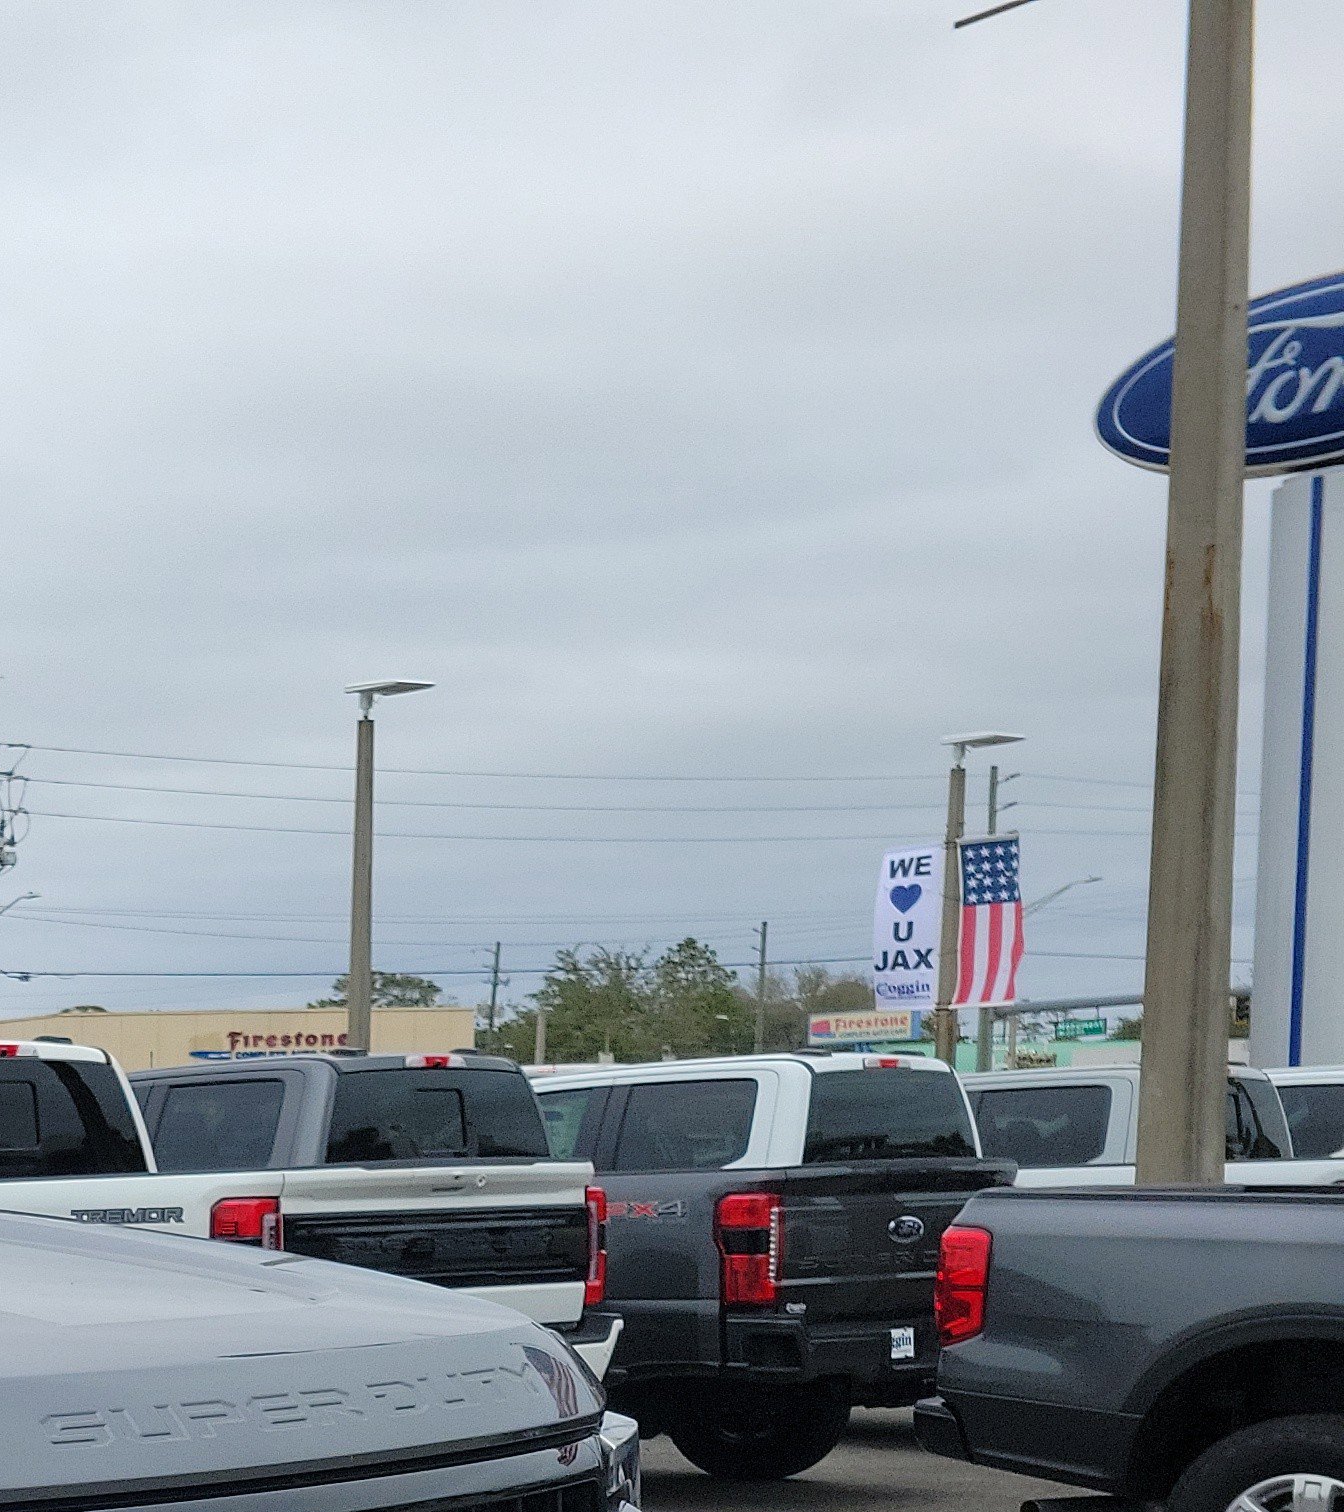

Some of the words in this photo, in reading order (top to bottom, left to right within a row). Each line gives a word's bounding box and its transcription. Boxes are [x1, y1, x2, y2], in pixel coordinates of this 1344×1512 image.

[890, 855, 932, 878] WE
[893, 921, 914, 942] U
[874, 949, 934, 972] JAX
[876, 980, 930, 997] Coggin
[835, 1015, 909, 1031] Firestone
[227, 1031, 349, 1051] Firestone
[71, 1207, 185, 1224] TREMOR
[39, 1388, 367, 1449] SUPER
[365, 1362, 541, 1416] DUTY
